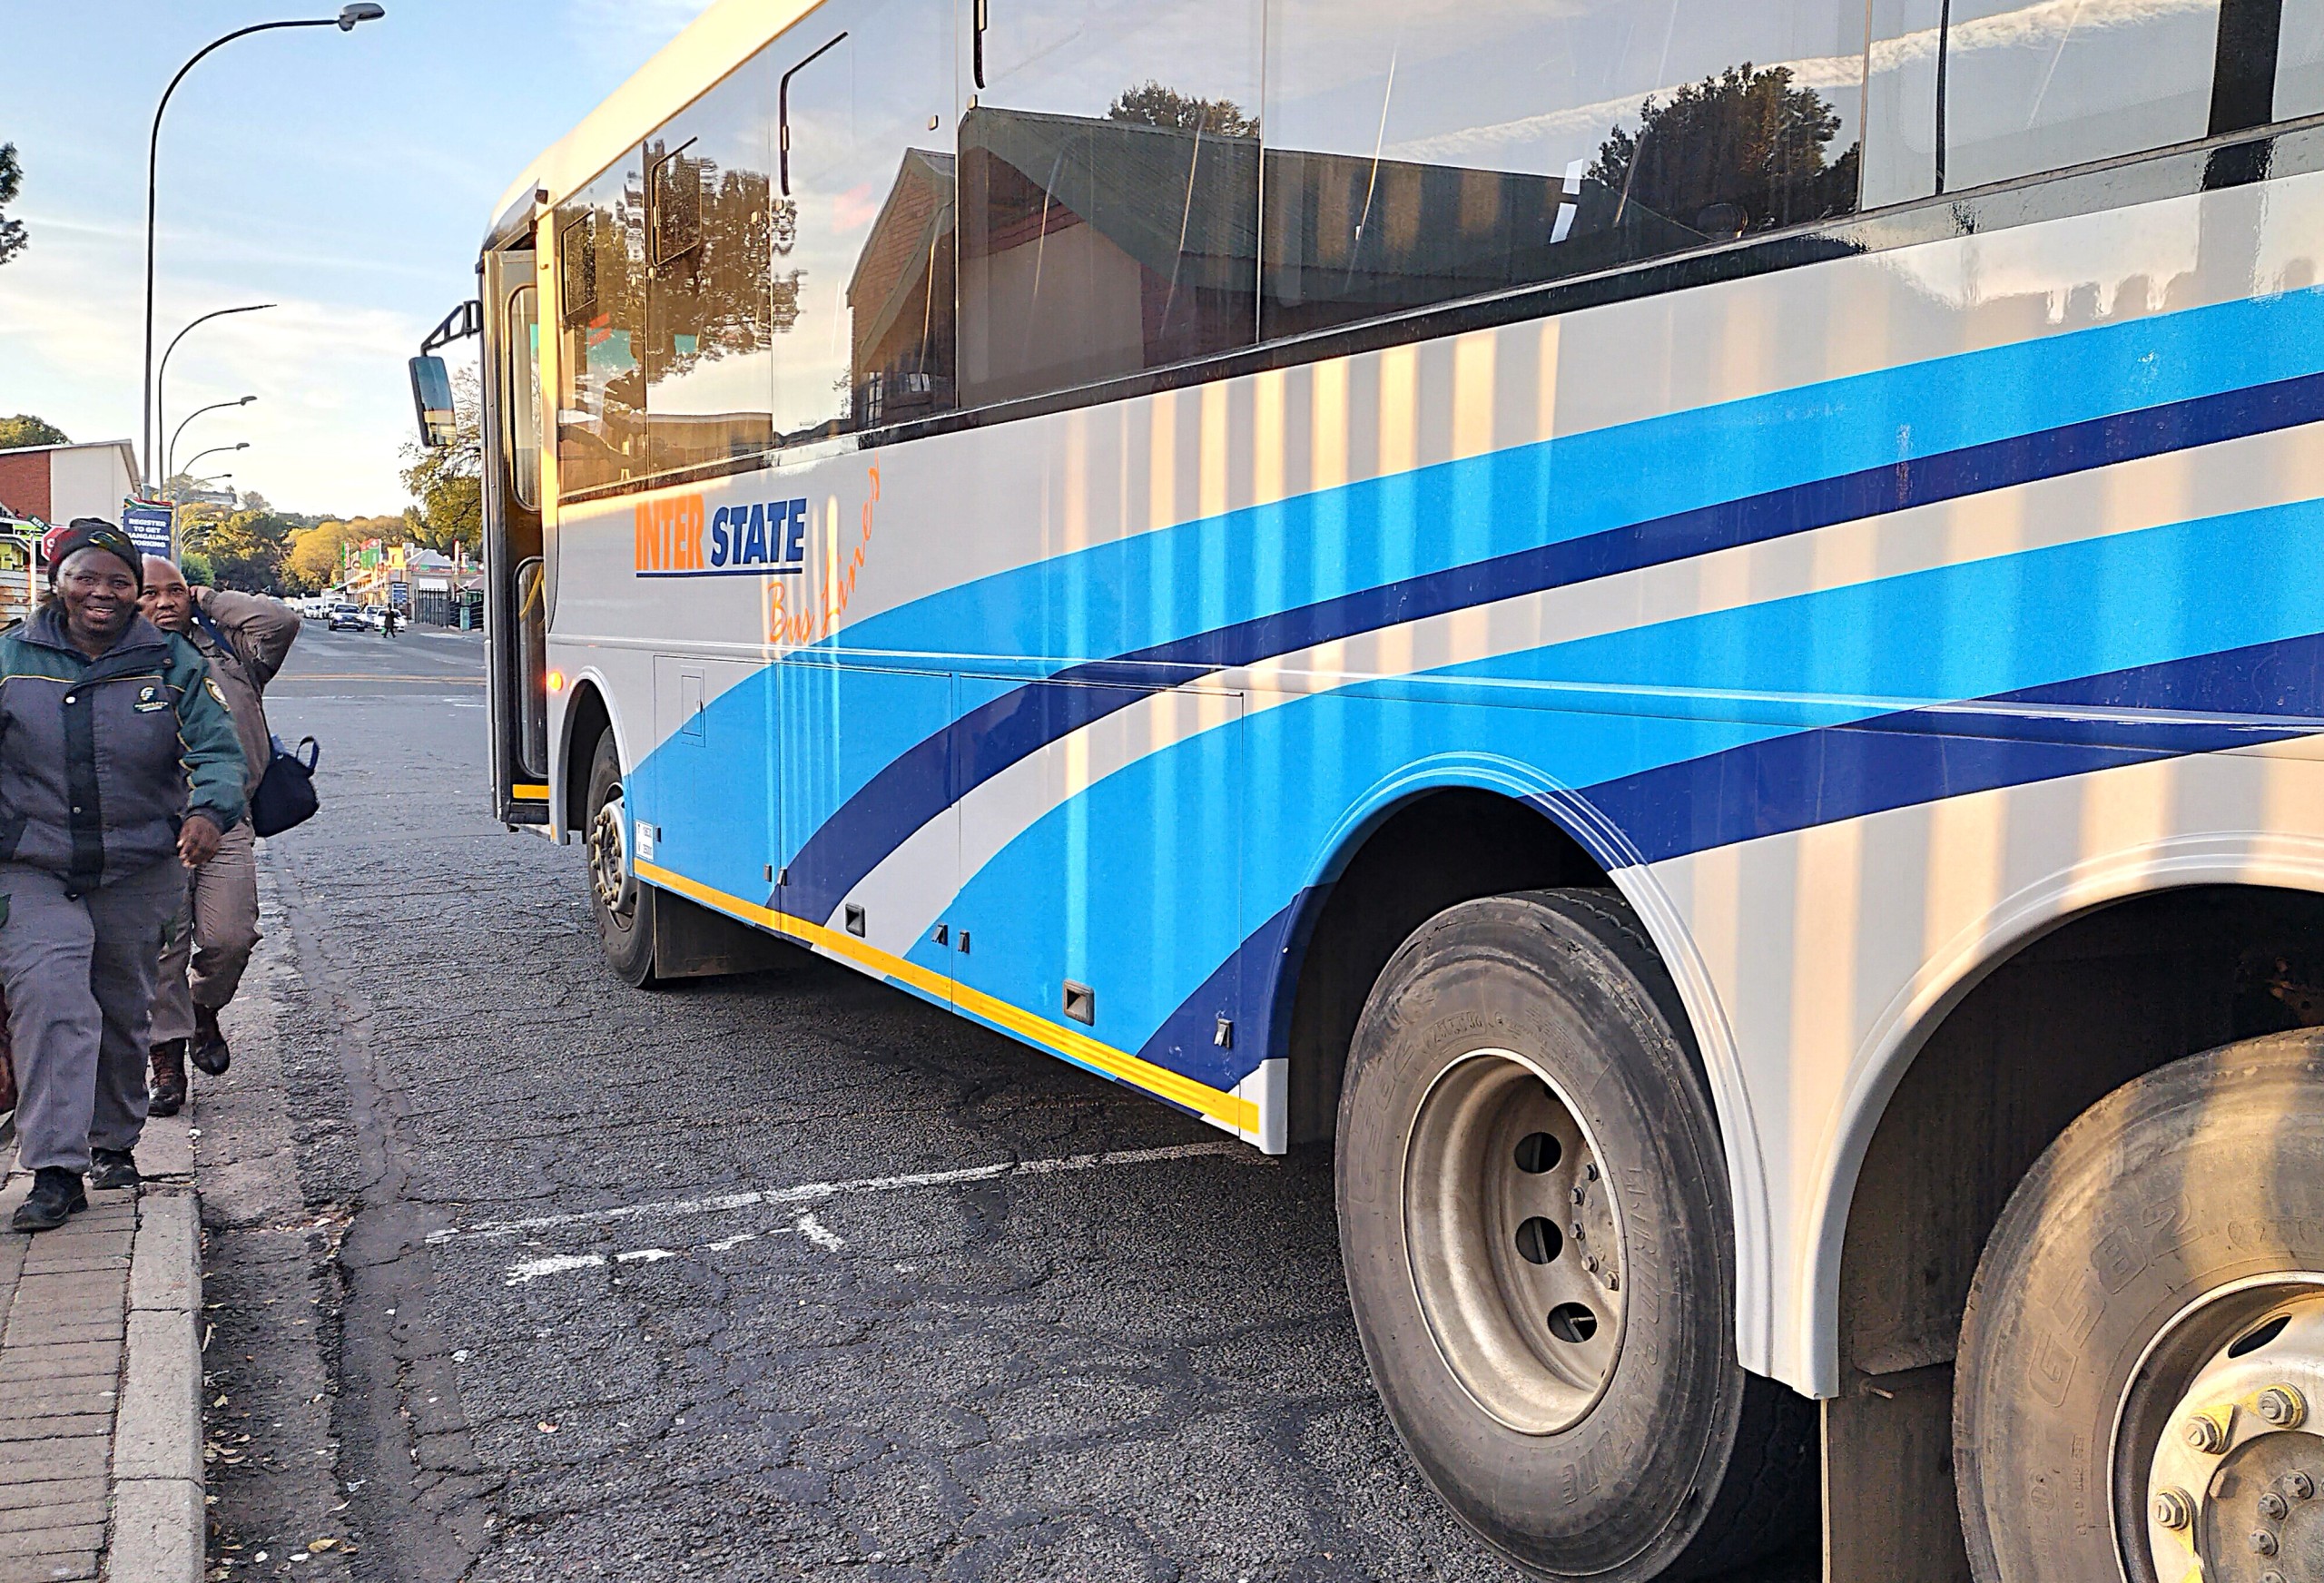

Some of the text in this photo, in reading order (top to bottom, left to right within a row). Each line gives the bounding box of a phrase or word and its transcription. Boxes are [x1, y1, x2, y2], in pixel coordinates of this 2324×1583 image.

[128, 517, 166, 526] REGISTER
[635, 494, 807, 571] INTER STATE
[768, 582, 814, 644] Bus
